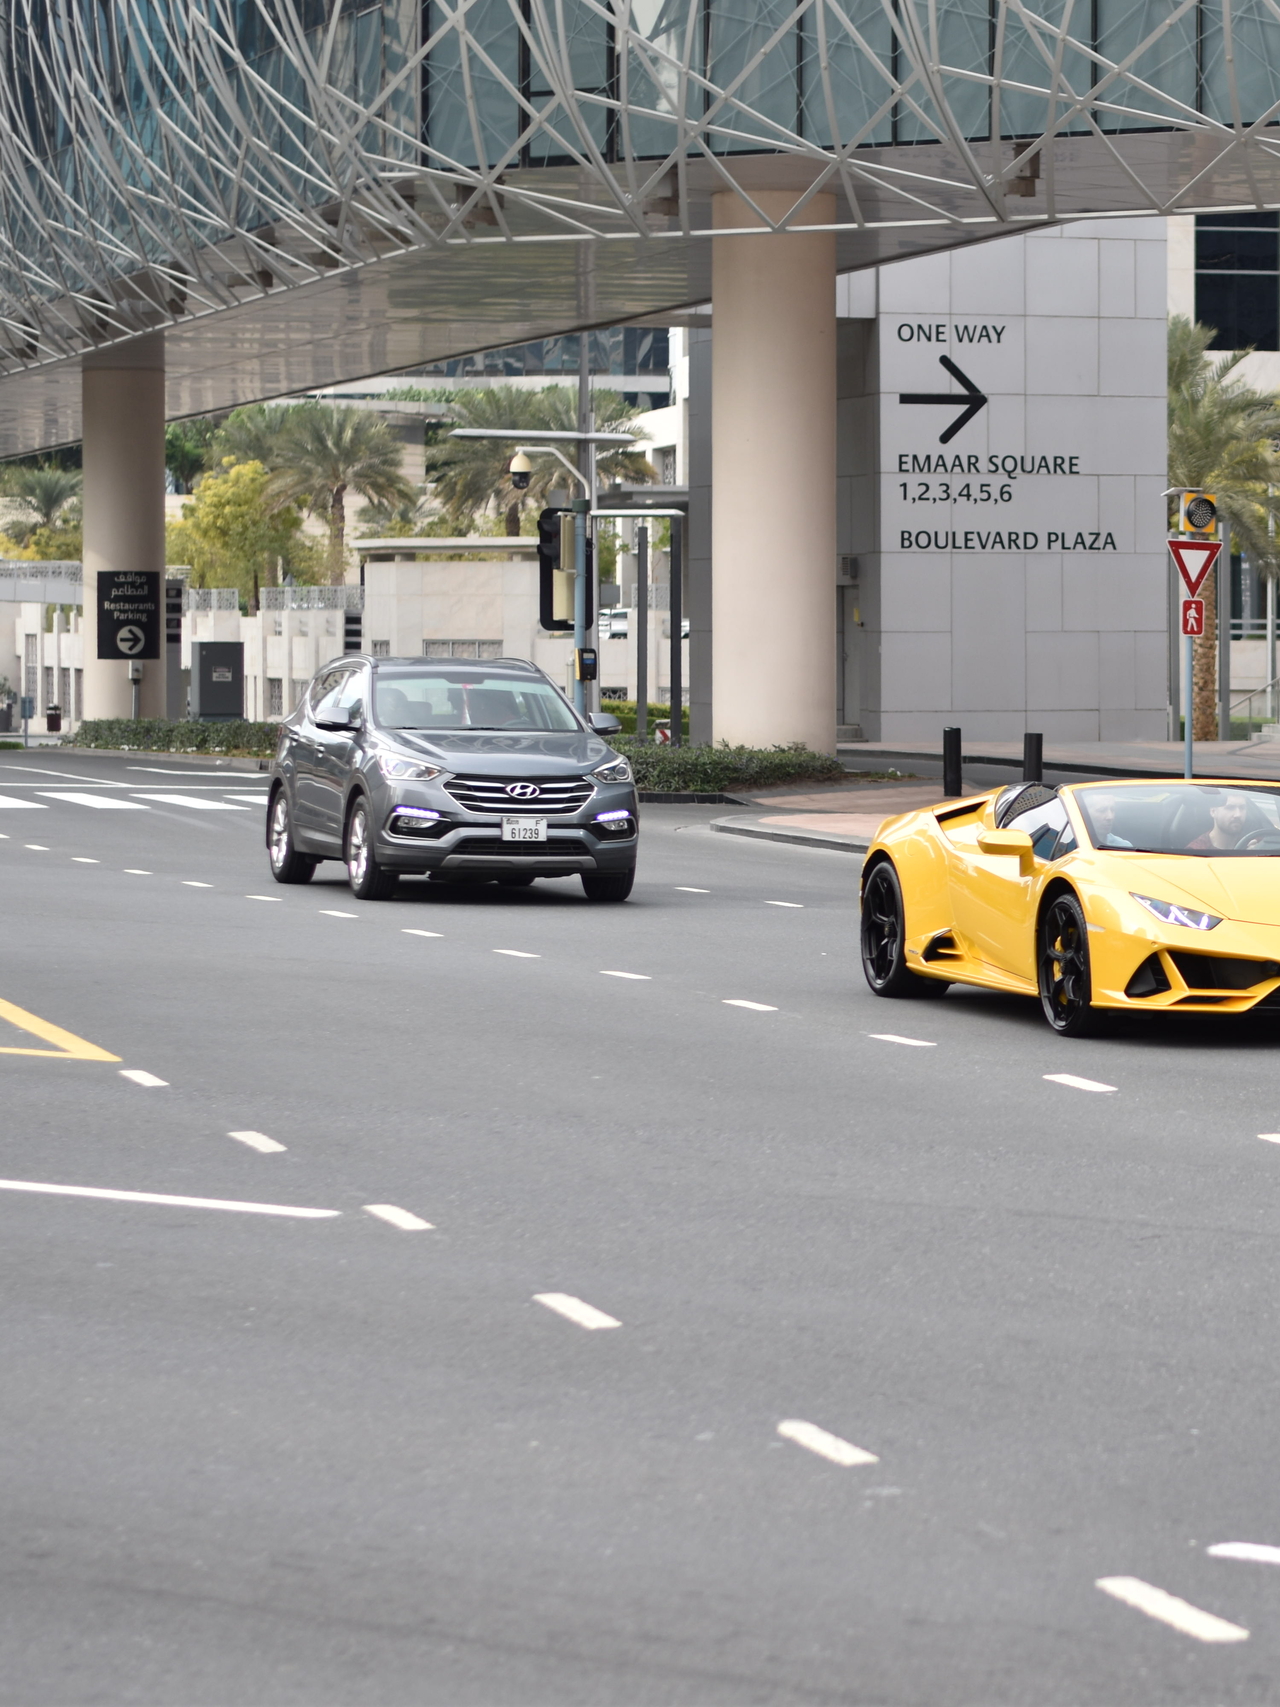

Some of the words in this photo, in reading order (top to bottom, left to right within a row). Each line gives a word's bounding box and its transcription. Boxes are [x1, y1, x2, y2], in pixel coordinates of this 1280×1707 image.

[897, 323, 947, 342] ONE
[954, 325, 1006, 343] WAY
[898, 454, 980, 473] EMAAR
[988, 455, 1080, 479] SQUARE
[899, 482, 1012, 504] 1,2,3,4,5,6
[900, 530, 1038, 550] BOULEVARD
[1047, 532, 1117, 550] PLAZA
[114, 572, 147, 586] مواقف
[111, 584, 148, 598] المطاعم
[104, 601, 155, 611] Restaurants
[113, 611, 147, 622] Parking
[511, 828, 540, 839] 61239
